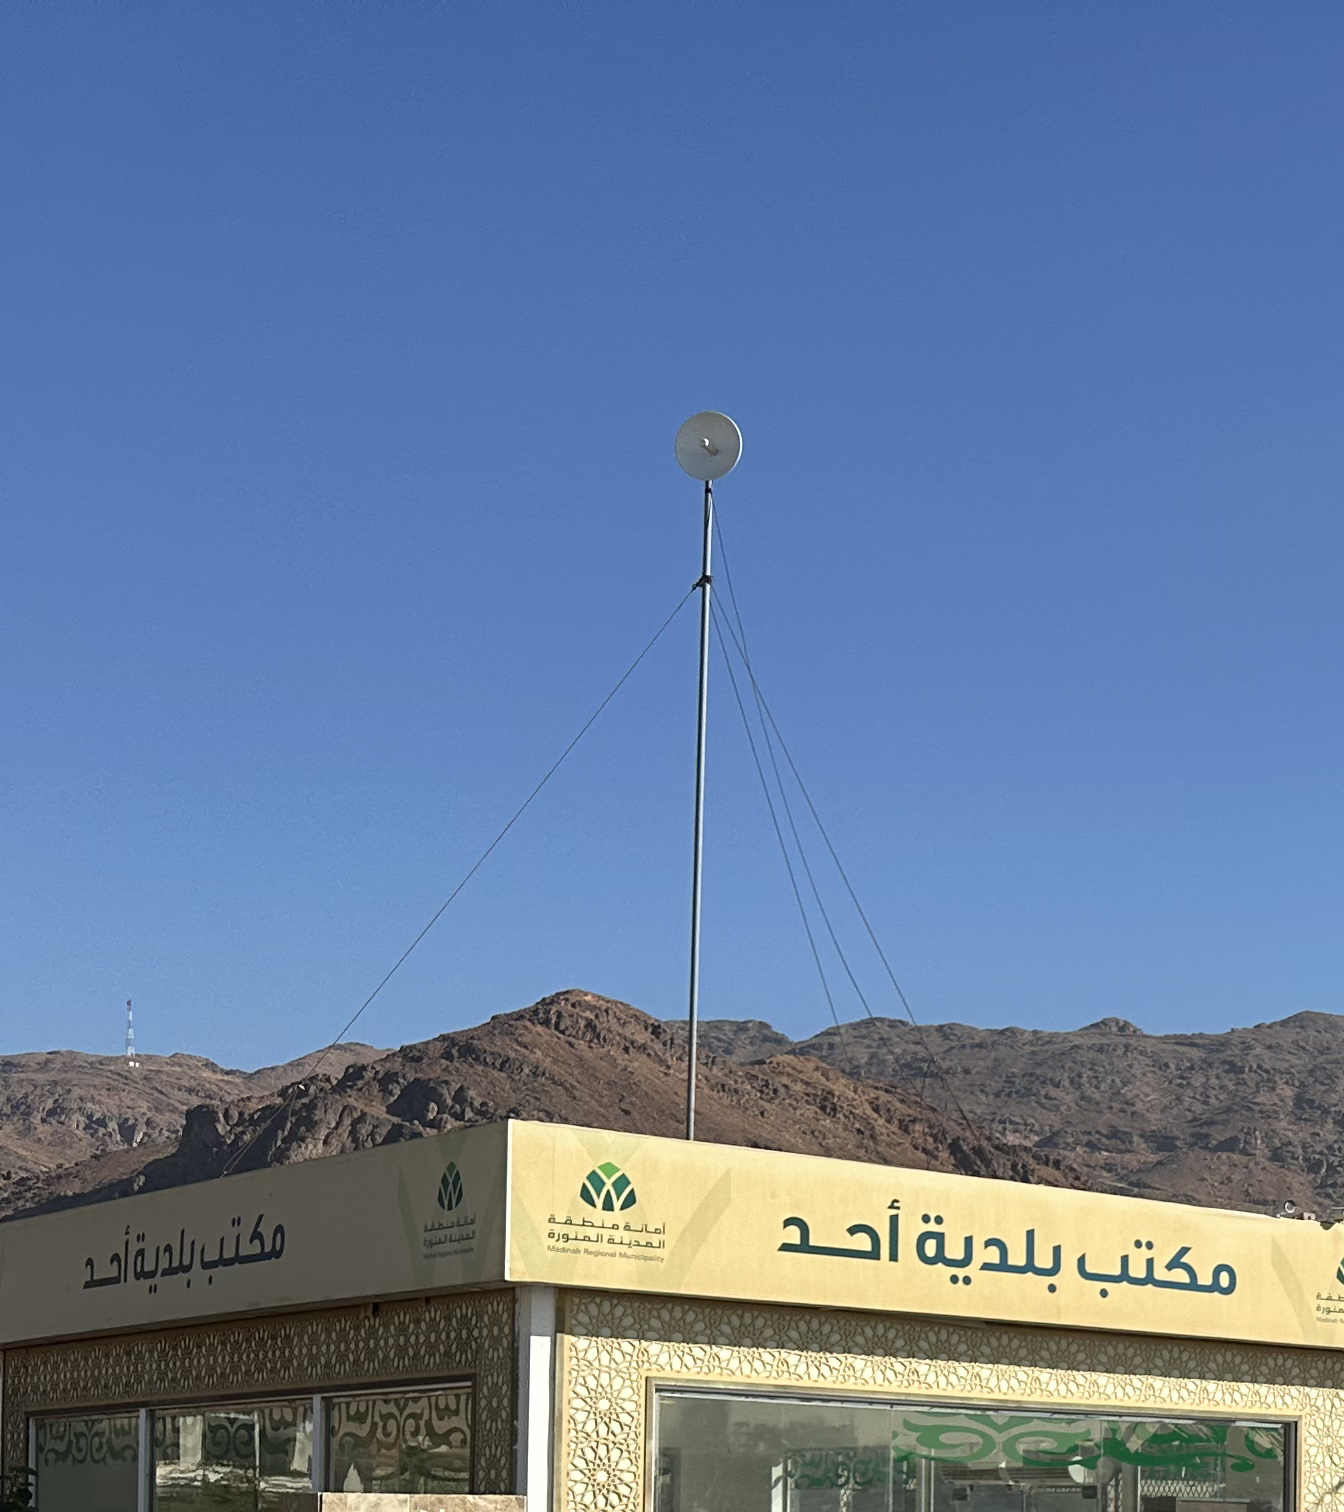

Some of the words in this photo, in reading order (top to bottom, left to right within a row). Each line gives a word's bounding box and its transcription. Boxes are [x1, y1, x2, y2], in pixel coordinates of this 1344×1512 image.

[200, 1213, 286, 1286] مكتب
[547, 1228, 604, 1244] المنورة
[547, 1244, 581, 1255] Madinah
[583, 1248, 617, 1258] Regional
[548, 1213, 620, 1231] منطقة
[606, 1234, 666, 1249] المدينة
[623, 1221, 666, 1235] أمانة
[777, 1198, 901, 1263] أحد
[83, 1224, 130, 1290] أحد
[133, 1228, 196, 1294] بلدية
[915, 1213, 1062, 1294] بلدية
[1077, 1239, 1237, 1299] مكتب
